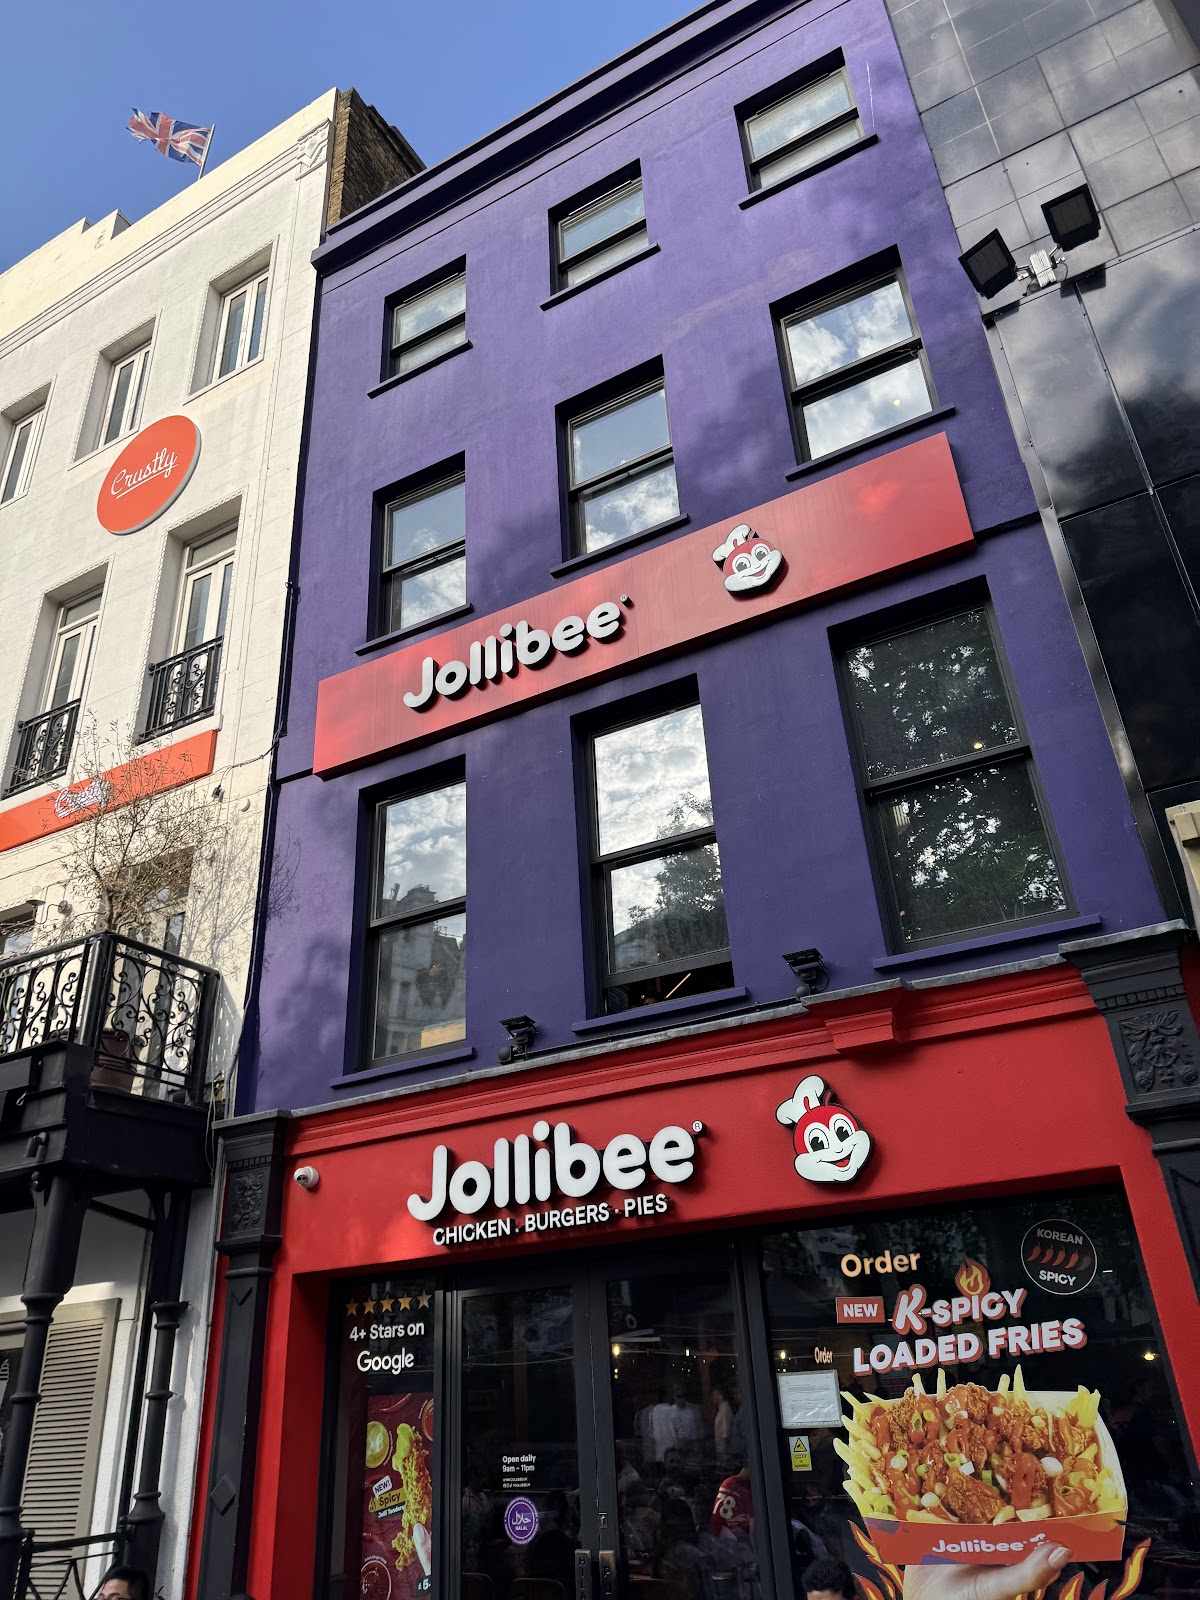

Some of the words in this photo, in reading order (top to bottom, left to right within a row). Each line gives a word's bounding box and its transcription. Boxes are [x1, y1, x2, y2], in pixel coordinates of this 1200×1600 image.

[111, 447, 179, 497] Crustly
[433, 1218, 511, 1246] CHICKEN
[524, 1202, 610, 1233] BURGERS
[624, 1193, 668, 1218] PIES
[1036, 1227, 1084, 1246] KOREAN
[841, 1250, 921, 1277] Order
[1038, 1269, 1077, 1287] SPICY
[843, 1303, 878, 1318] NEW
[893, 1285, 1026, 1333] K-SPICY
[349, 1326, 366, 1341] 4+
[369, 1324, 405, 1340] Stars
[407, 1322, 424, 1336] on
[814, 1346, 833, 1364] Order
[854, 1333, 981, 1375] LOADED
[988, 1318, 1086, 1357] FRIES
[357, 1347, 415, 1375] Google
[502, 1455, 519, 1464] Open
[520, 1454, 537, 1463] daily
[502, 1464, 516, 1472] 9am
[521, 1464, 535, 1473] 11pm
[374, 1480, 391, 1494] NEW!
[379, 1493, 401, 1507] Spicy
[712, 1493, 736, 1519] 78
[932, 1539, 1024, 1553] Jollibee
